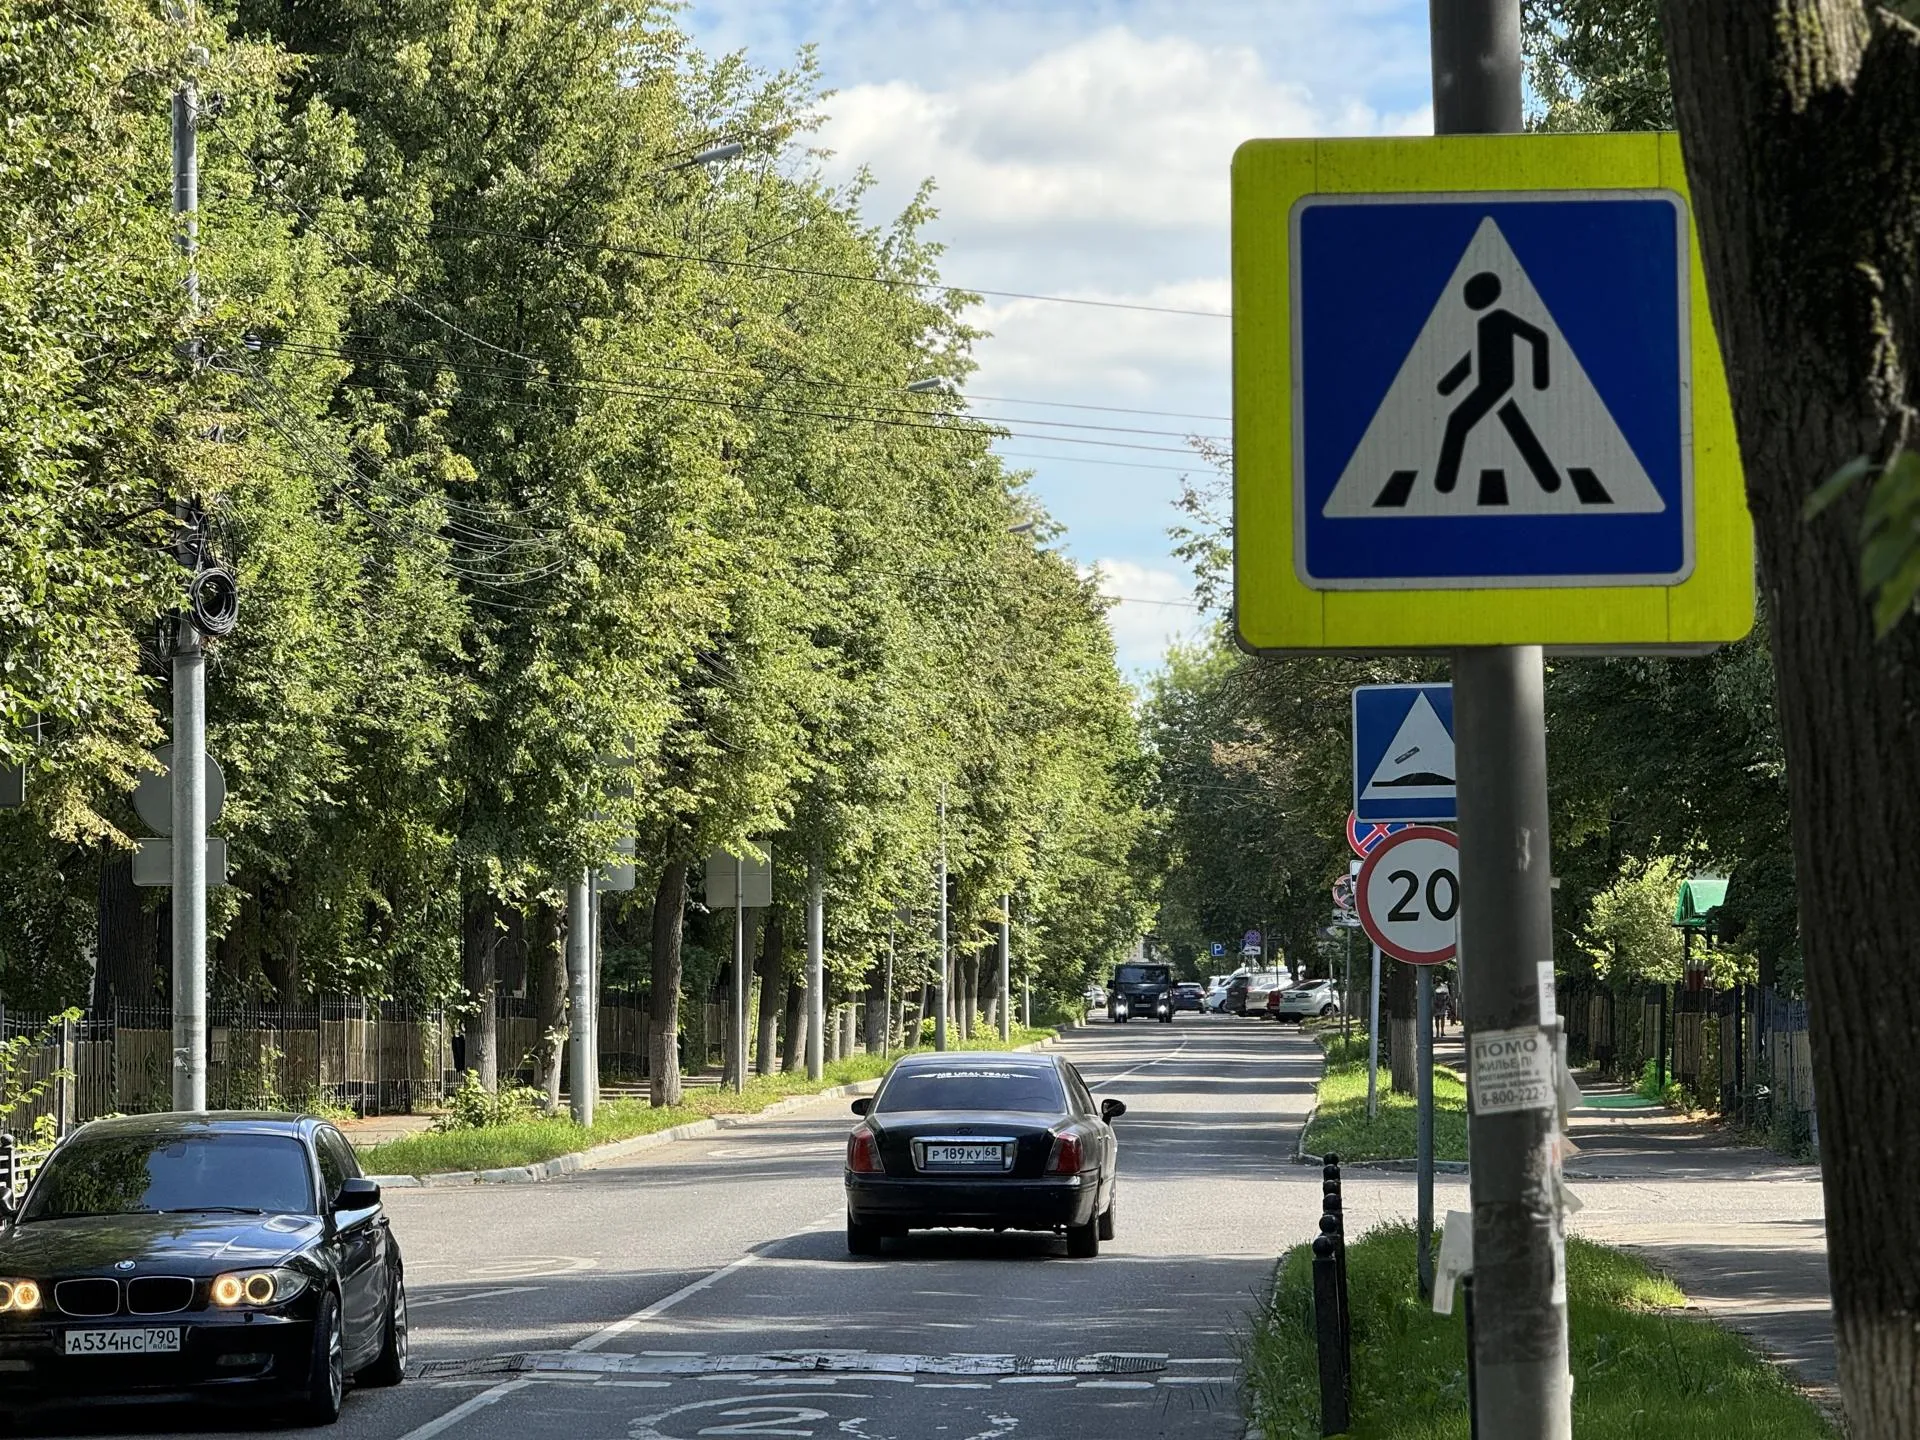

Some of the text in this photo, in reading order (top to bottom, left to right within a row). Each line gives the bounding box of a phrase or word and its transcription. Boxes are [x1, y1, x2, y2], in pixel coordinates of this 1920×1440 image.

[1387, 868, 1460, 922] 20
[1213, 943, 1222, 955] P
[1475, 1039, 1538, 1059] ПОМО
[984, 1147, 997, 1156] 68
[71, 1330, 175, 1351] А534НС 790
